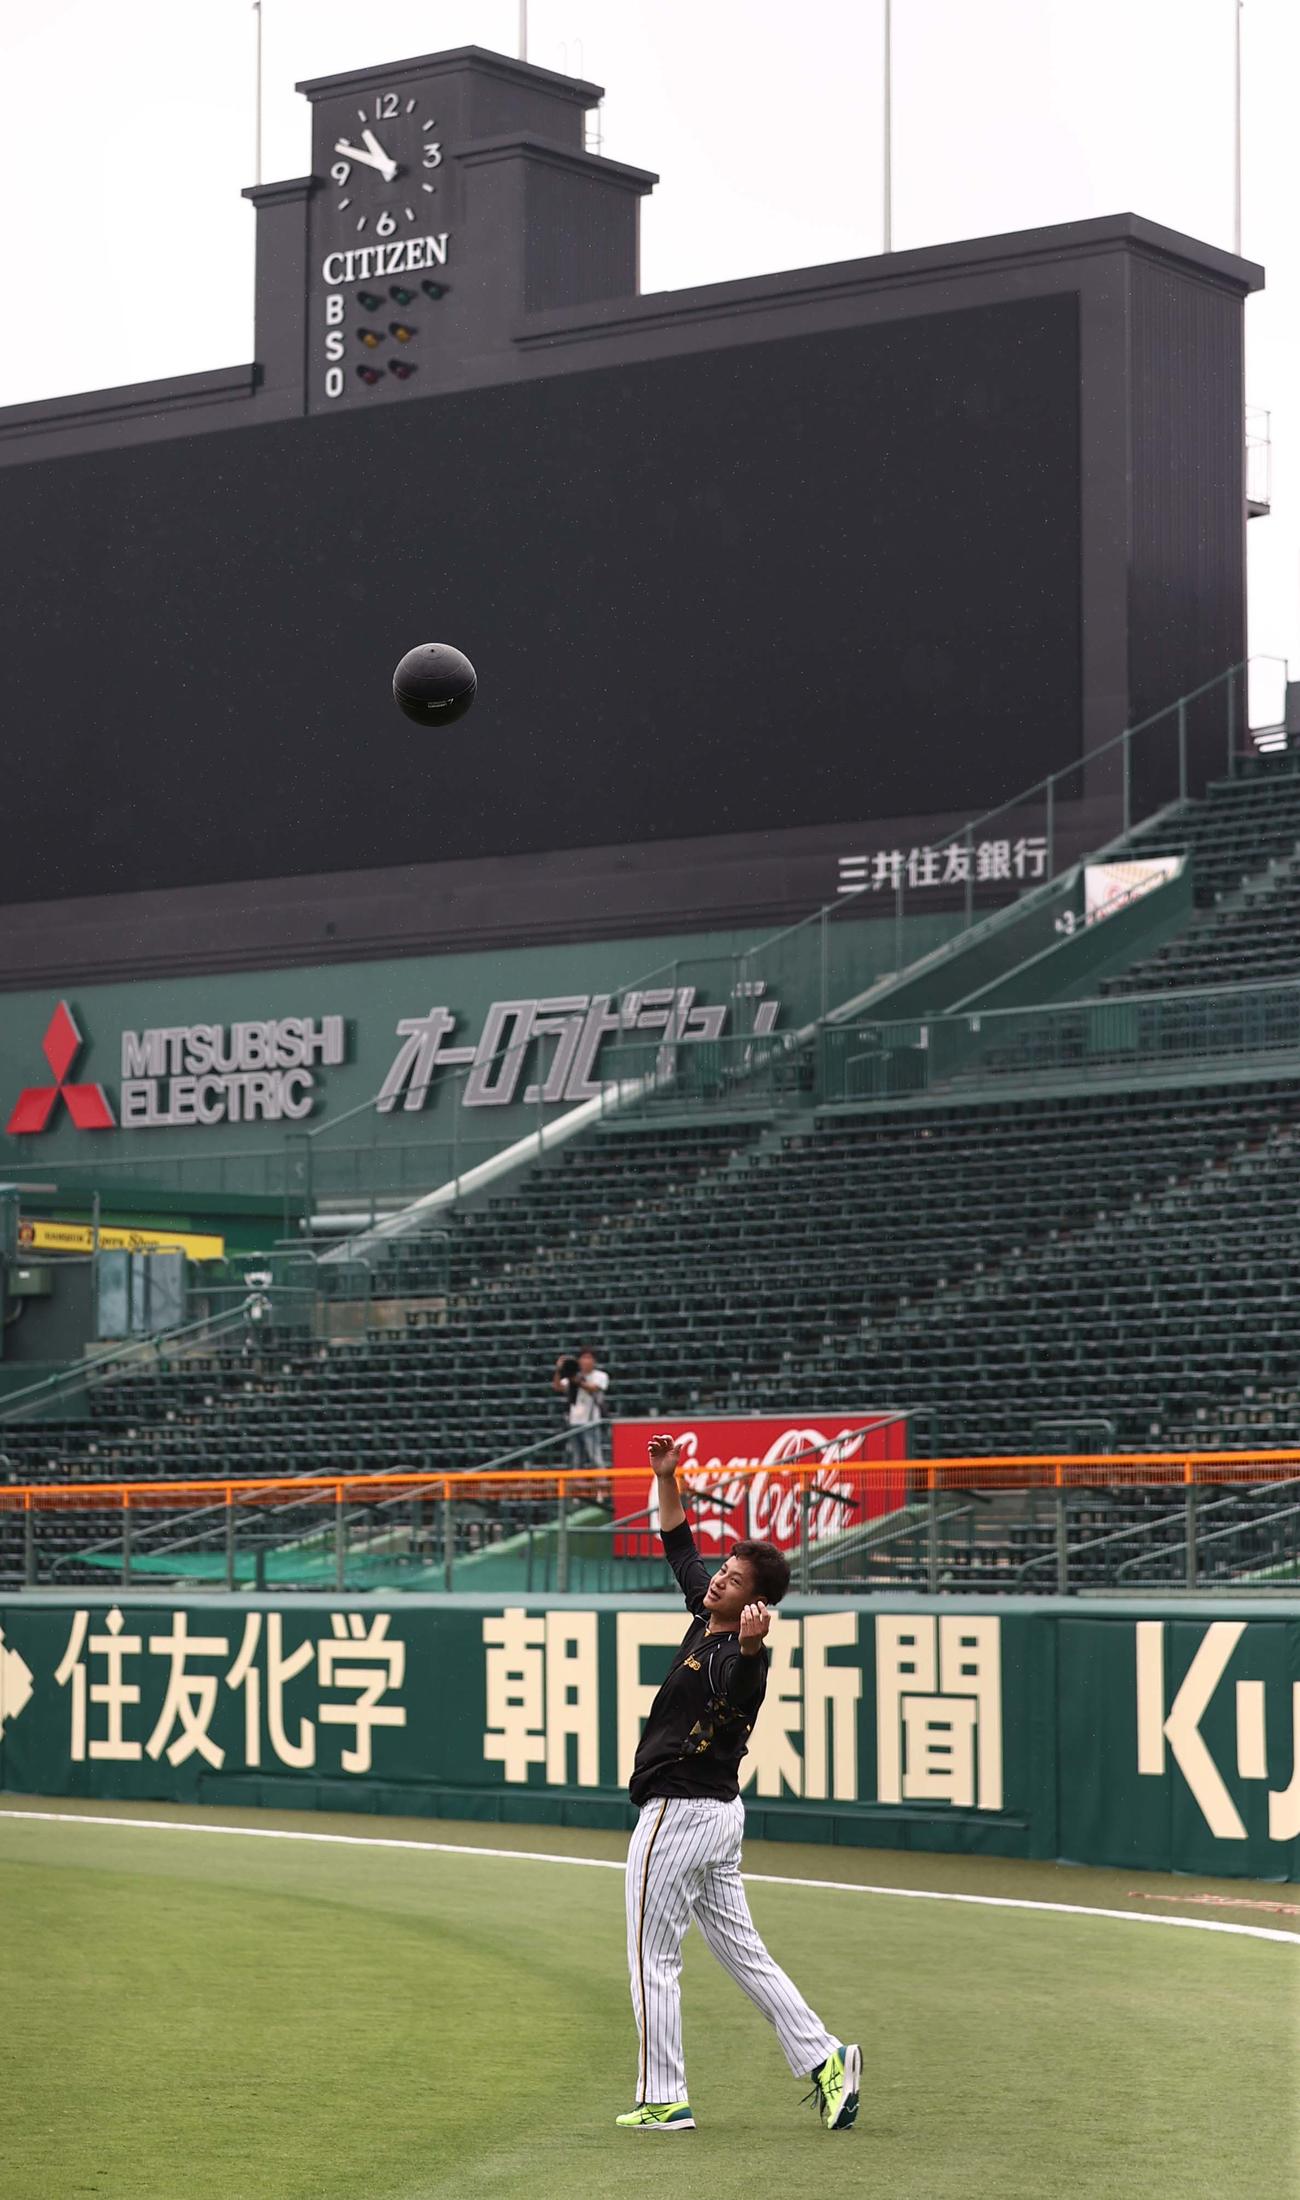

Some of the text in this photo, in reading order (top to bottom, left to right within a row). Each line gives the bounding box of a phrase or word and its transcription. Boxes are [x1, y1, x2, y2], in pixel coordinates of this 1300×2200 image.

[375, 93, 400, 119] 12
[423, 143, 442, 168] 3
[330, 161, 350, 186] 9
[375, 211, 395, 236] 6
[322, 233, 449, 286] CITIZEN
[326, 294, 344, 325] B
[326, 331, 344, 361] S
[325, 367, 344, 398] O
[837, 836, 1048, 894] 三井住友銀行
[121, 1015, 344, 1078] MITSUBISHI
[121, 1069, 314, 1129] ELECTRIC
[54, 1604, 406, 1773] 住友化学
